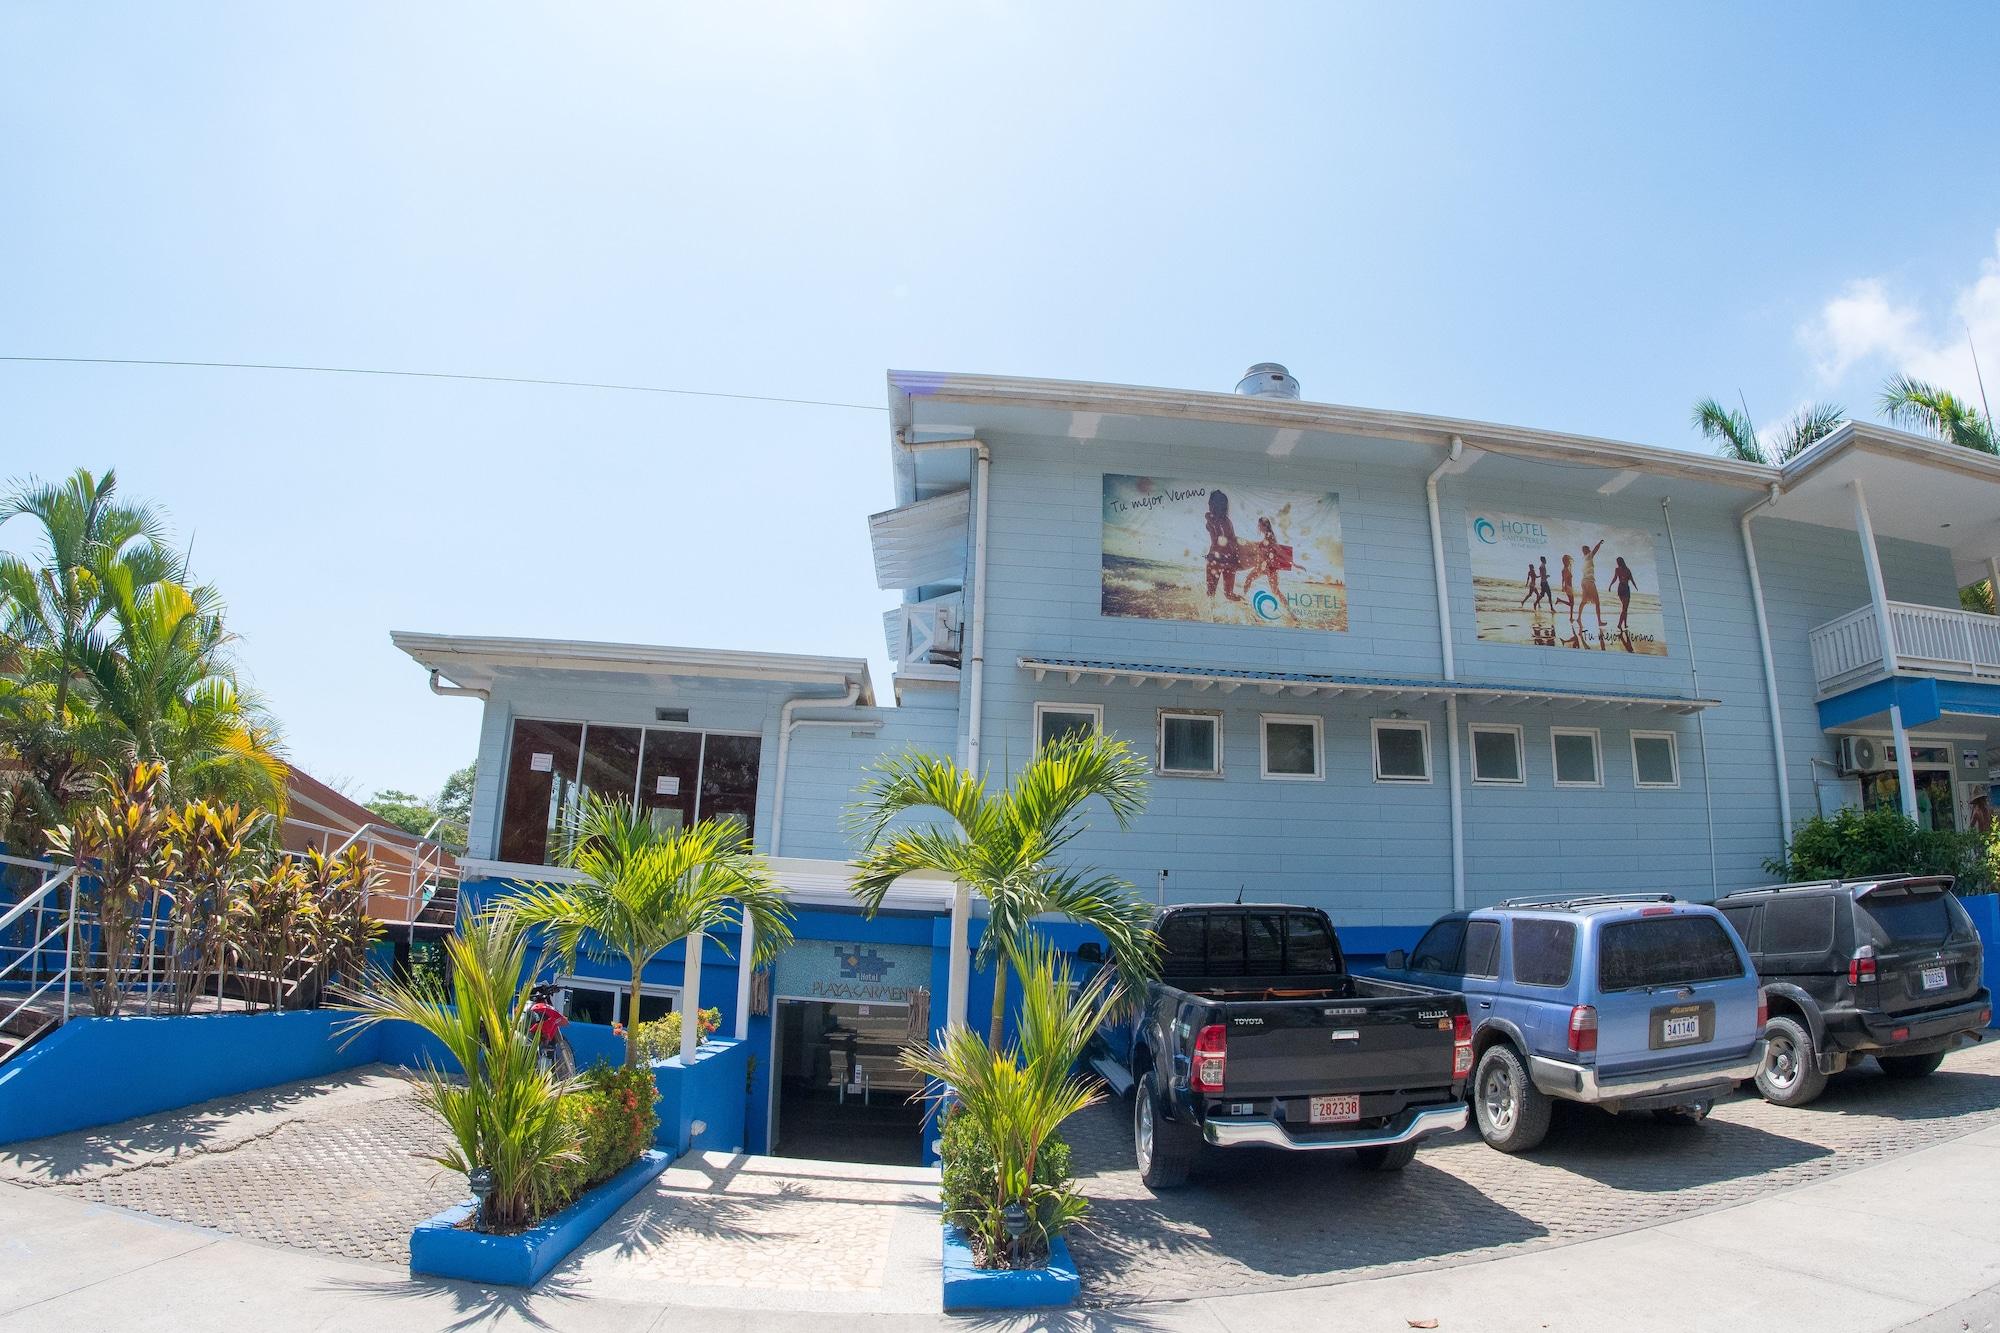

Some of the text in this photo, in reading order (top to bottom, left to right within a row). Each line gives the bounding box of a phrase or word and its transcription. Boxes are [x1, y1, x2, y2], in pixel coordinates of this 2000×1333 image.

[1110, 488, 1206, 512] Tu mejor Verano
[1502, 519, 1548, 537] HOTEL
[1287, 592, 1342, 609] HOTEL
[860, 972, 878, 980] Hotel
[1418, 1009, 1449, 1019] HILUX
[1667, 1021, 1695, 1035] 341140
[1319, 1101, 1357, 1117] 282338
